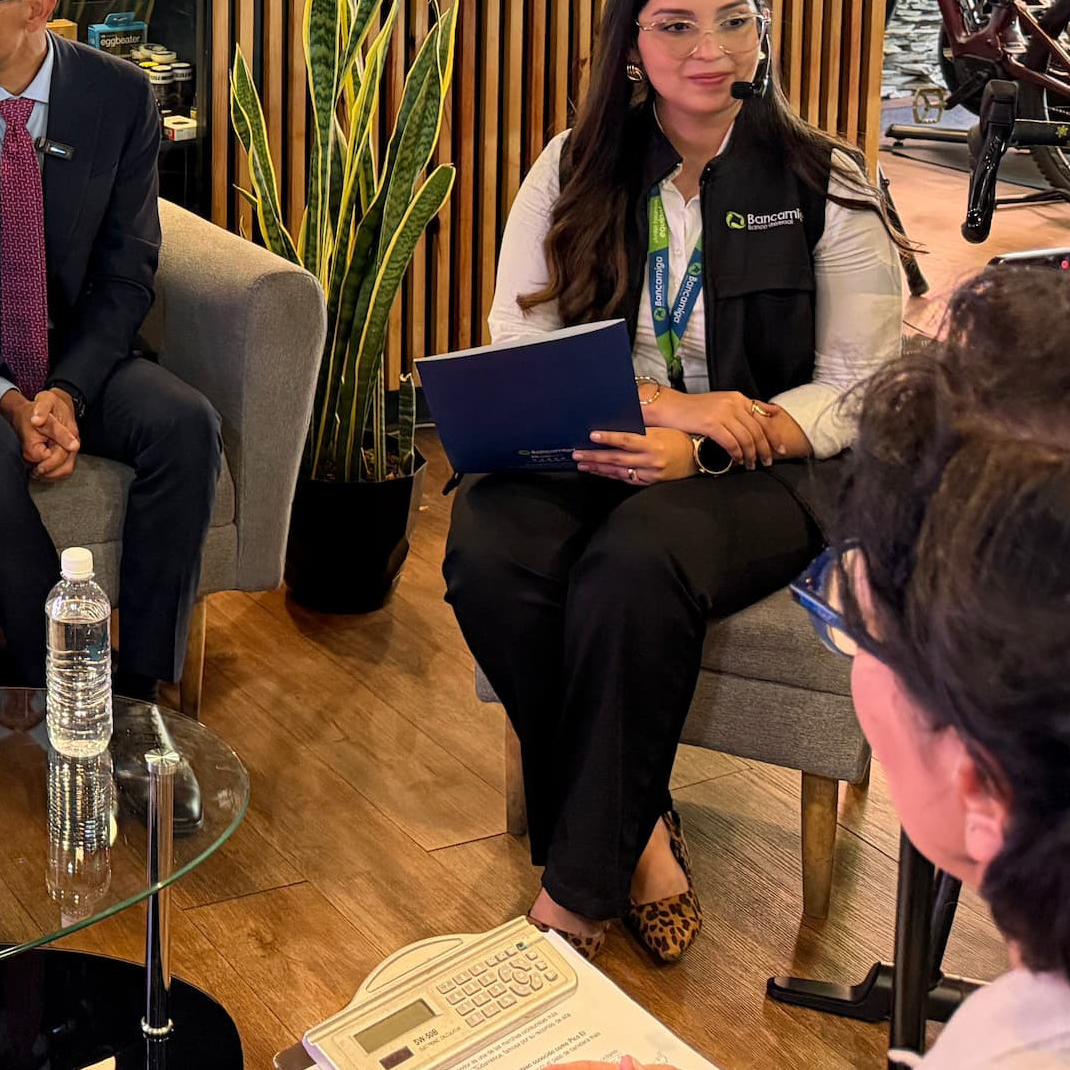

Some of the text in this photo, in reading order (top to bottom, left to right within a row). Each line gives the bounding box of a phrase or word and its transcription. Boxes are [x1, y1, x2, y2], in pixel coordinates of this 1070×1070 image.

[100, 35, 140, 48] eggbeater
[654, 256, 665, 306] Bancamigo
[673, 275, 697, 324] Bancamigo
